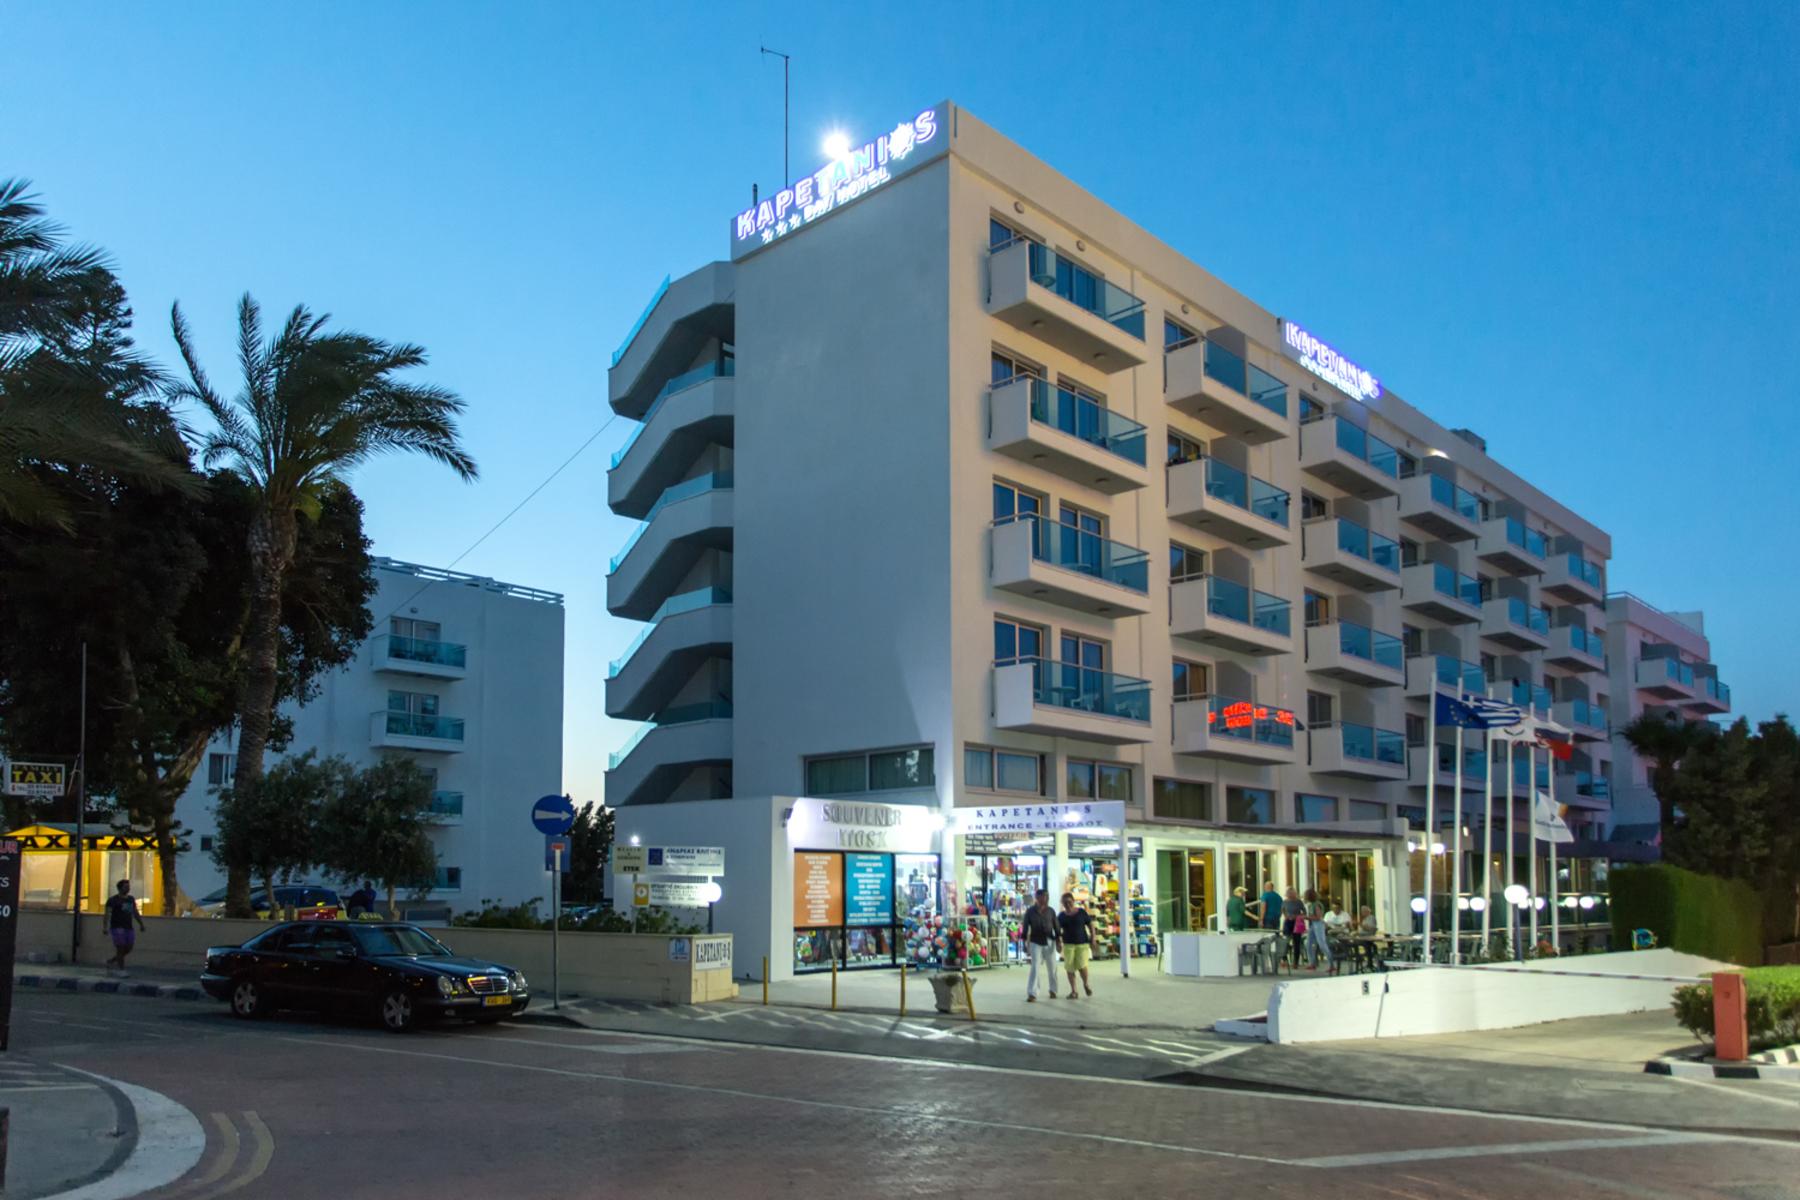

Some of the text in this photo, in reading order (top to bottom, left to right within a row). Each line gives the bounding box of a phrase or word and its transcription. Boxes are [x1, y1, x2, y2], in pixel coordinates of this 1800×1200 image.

[837, 166, 891, 205] HOTEL
[13, 771, 61, 784] TAXI
[968, 822, 1033, 831] ENTRANCE
[836, 829, 888, 848] KIOSK
